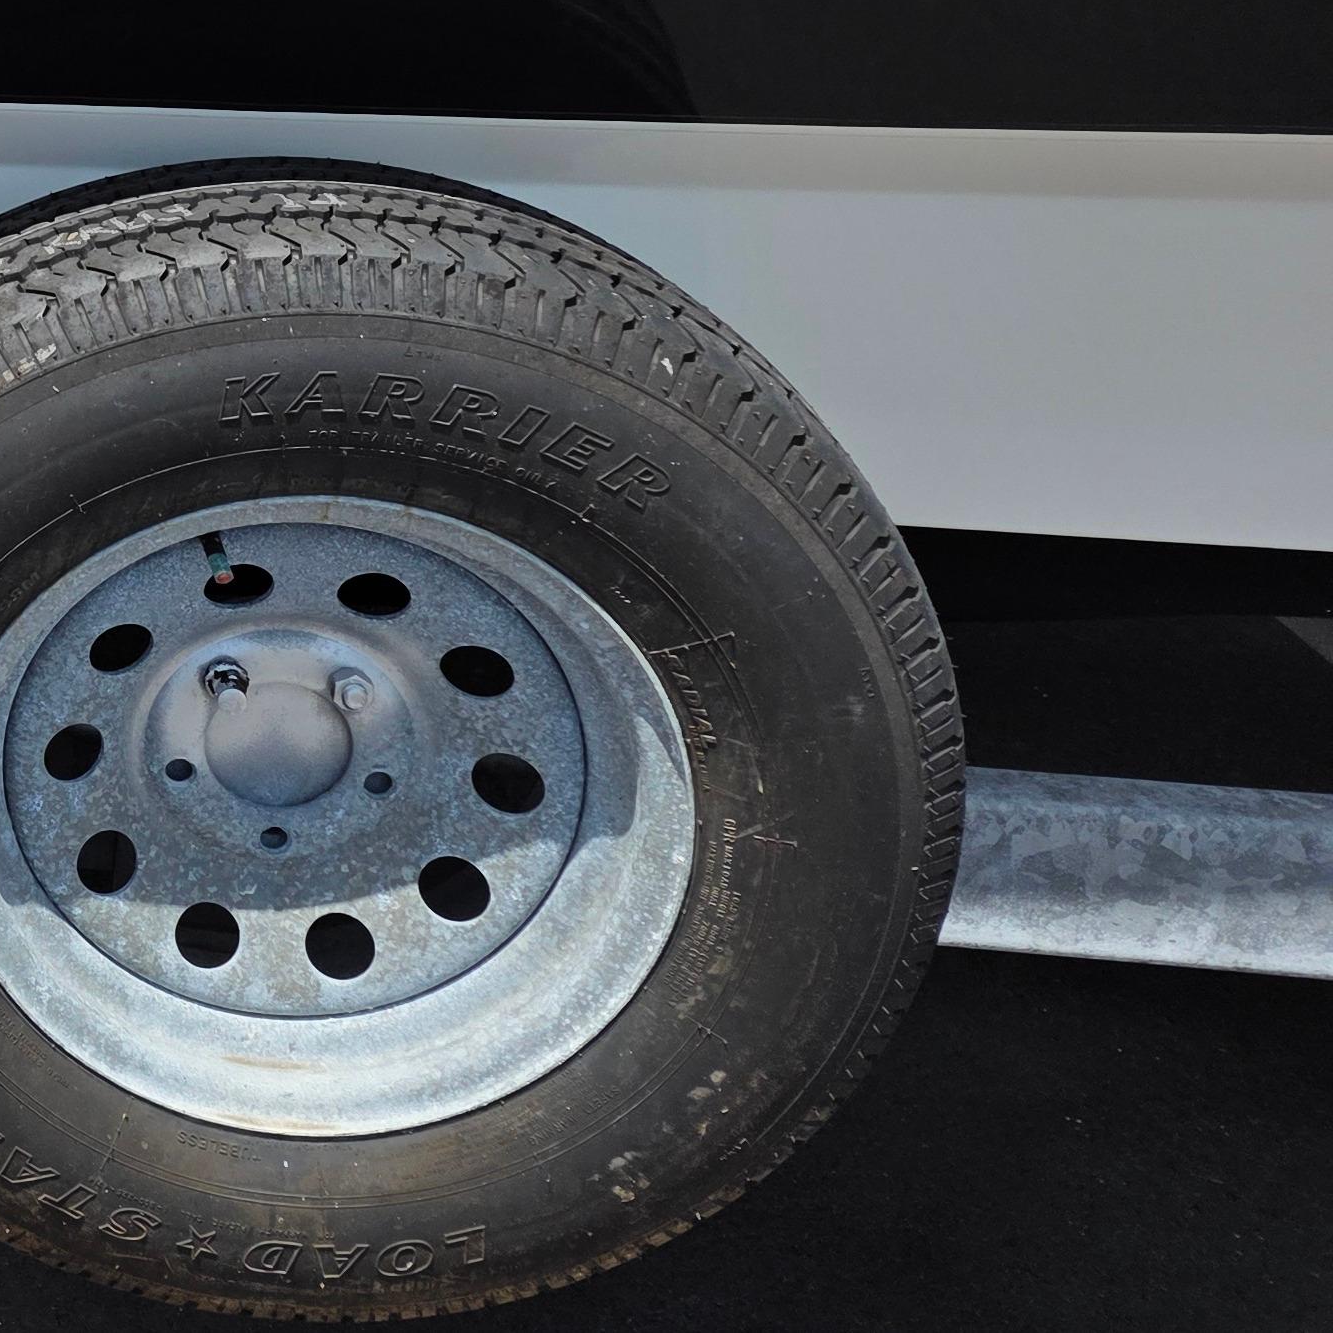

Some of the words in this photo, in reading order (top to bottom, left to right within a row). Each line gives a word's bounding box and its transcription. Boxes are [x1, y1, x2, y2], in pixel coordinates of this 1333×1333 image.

[217, 369, 671, 512] KARRIER
[432, 441, 510, 470] SERVICE
[177, 1130, 262, 1163] TUBELESS
[241, 1224, 486, 1279] LOAD
